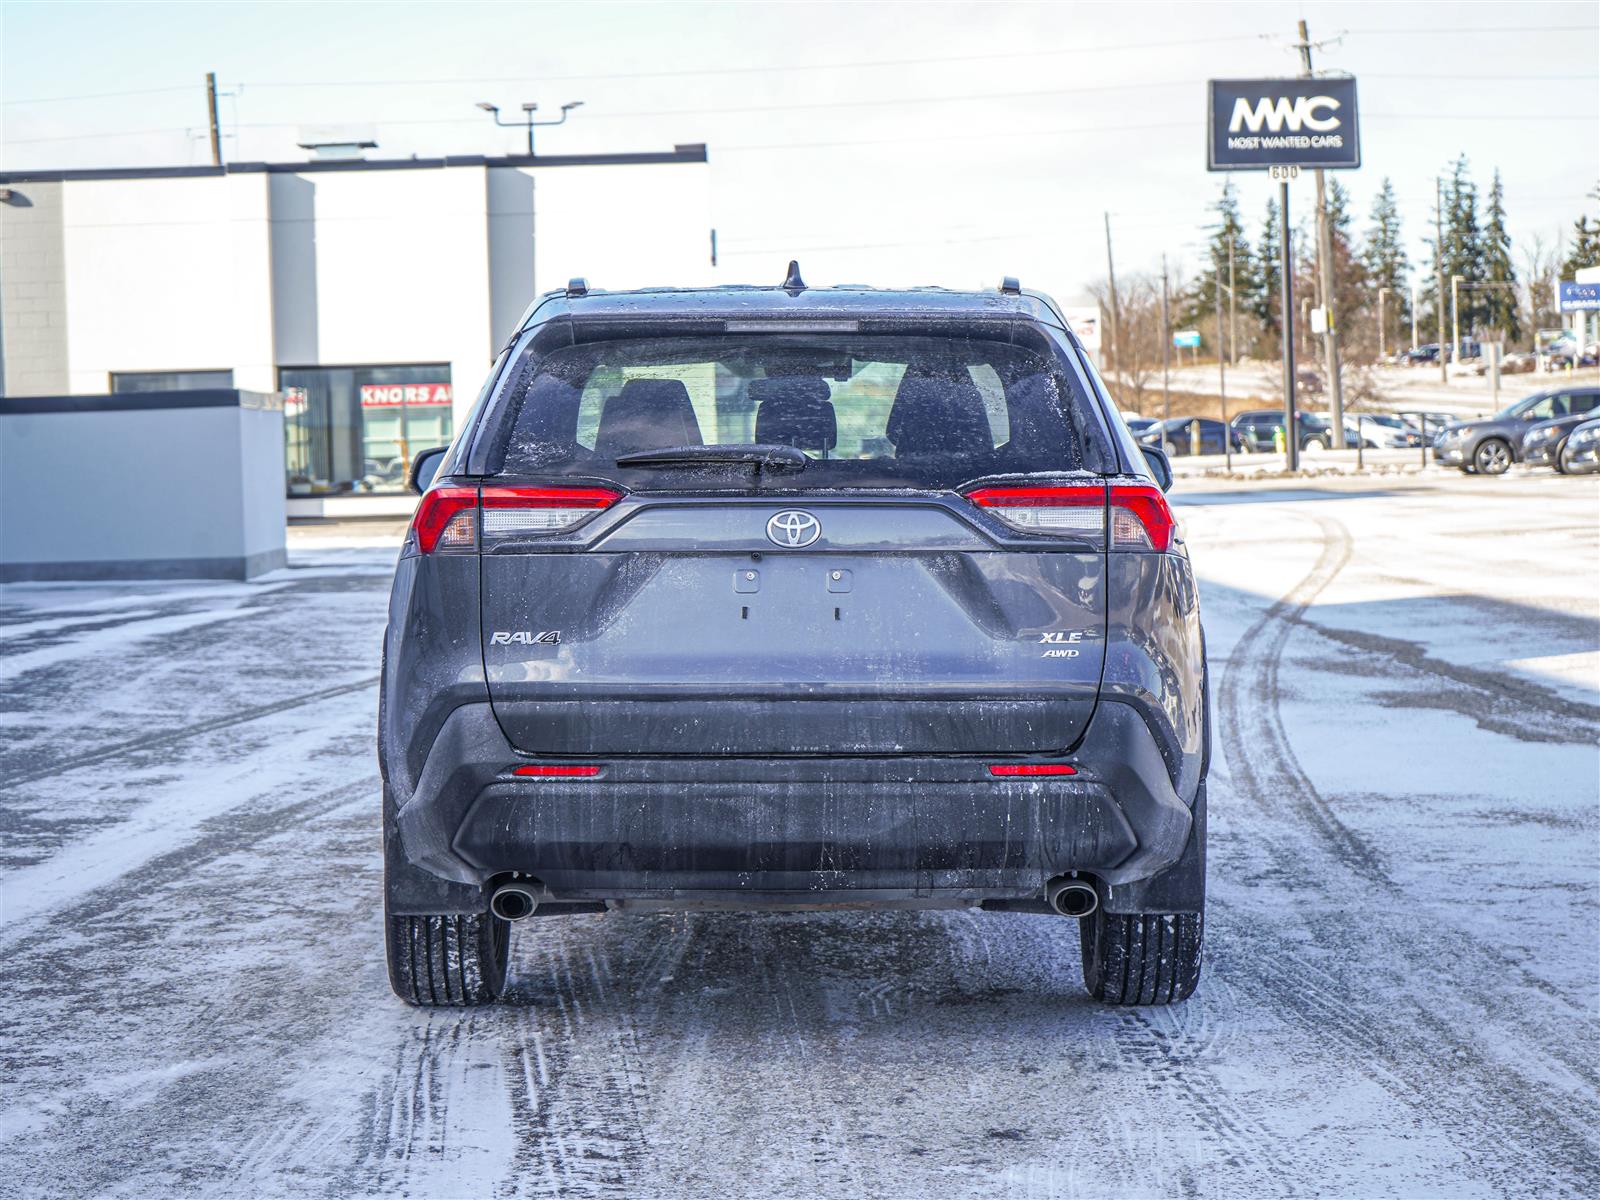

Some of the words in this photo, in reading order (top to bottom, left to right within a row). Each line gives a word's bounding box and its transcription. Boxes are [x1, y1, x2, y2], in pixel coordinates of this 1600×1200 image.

[1228, 95, 1341, 133] MWC
[1228, 136, 1260, 150] MOST
[1261, 135, 1310, 149] WANTED
[1311, 134, 1344, 149] CARS
[1272, 165, 1298, 179] 600
[490, 630, 562, 646] RAV4
[1038, 632, 1083, 644] XLE
[1041, 649, 1079, 658] AWD
